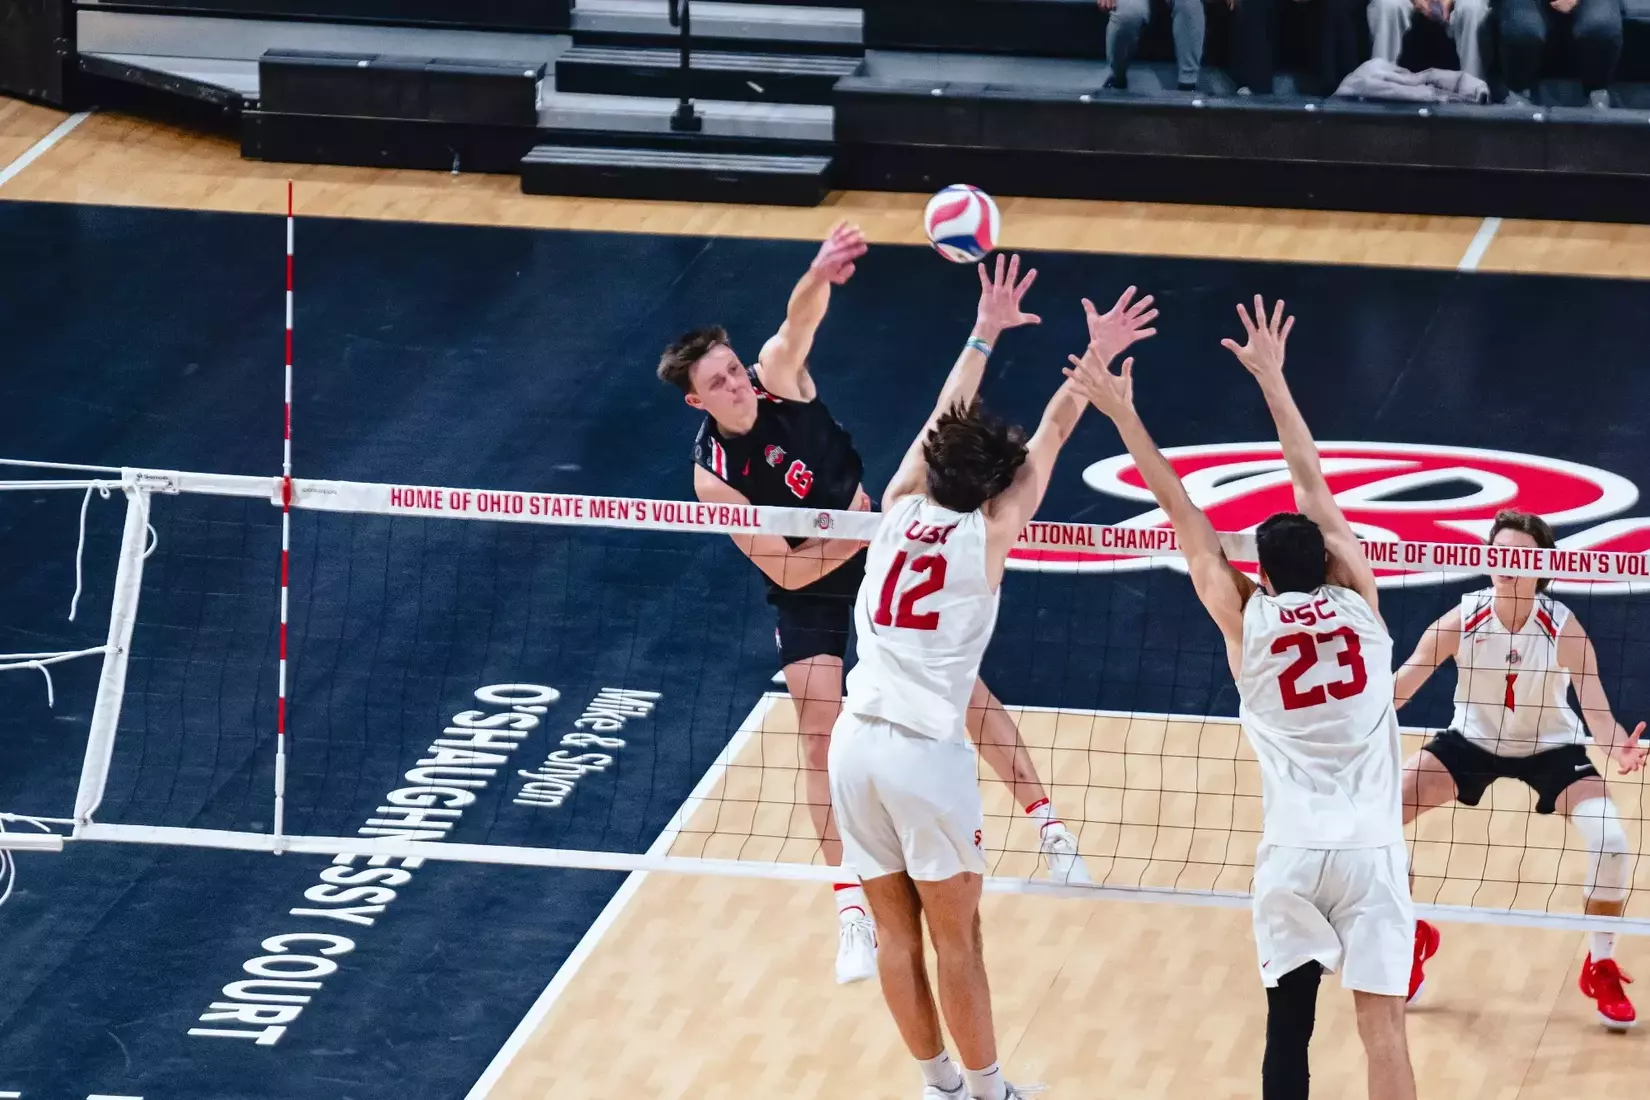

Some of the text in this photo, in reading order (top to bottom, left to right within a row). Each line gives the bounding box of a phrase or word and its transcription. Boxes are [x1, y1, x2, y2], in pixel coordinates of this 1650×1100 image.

[390, 487, 761, 528] HOME OF OHIO STATE MEN'S VOLLEYBALL
[1018, 523, 1182, 551] ATIONAL CHAMPI
[1404, 543, 1427, 564] OF
[1433, 544, 1481, 567] OHIO
[1487, 547, 1543, 570] STATE
[1549, 550, 1610, 574] MEN'S
[1616, 554, 1649, 576] VOL
[873, 549, 948, 631] 12
[1279, 598, 1337, 626] USC
[1270, 626, 1368, 711] 23
[574, 687, 663, 732] Mike
[513, 750, 613, 808] Shyan
[187, 932, 356, 1046] COURT
